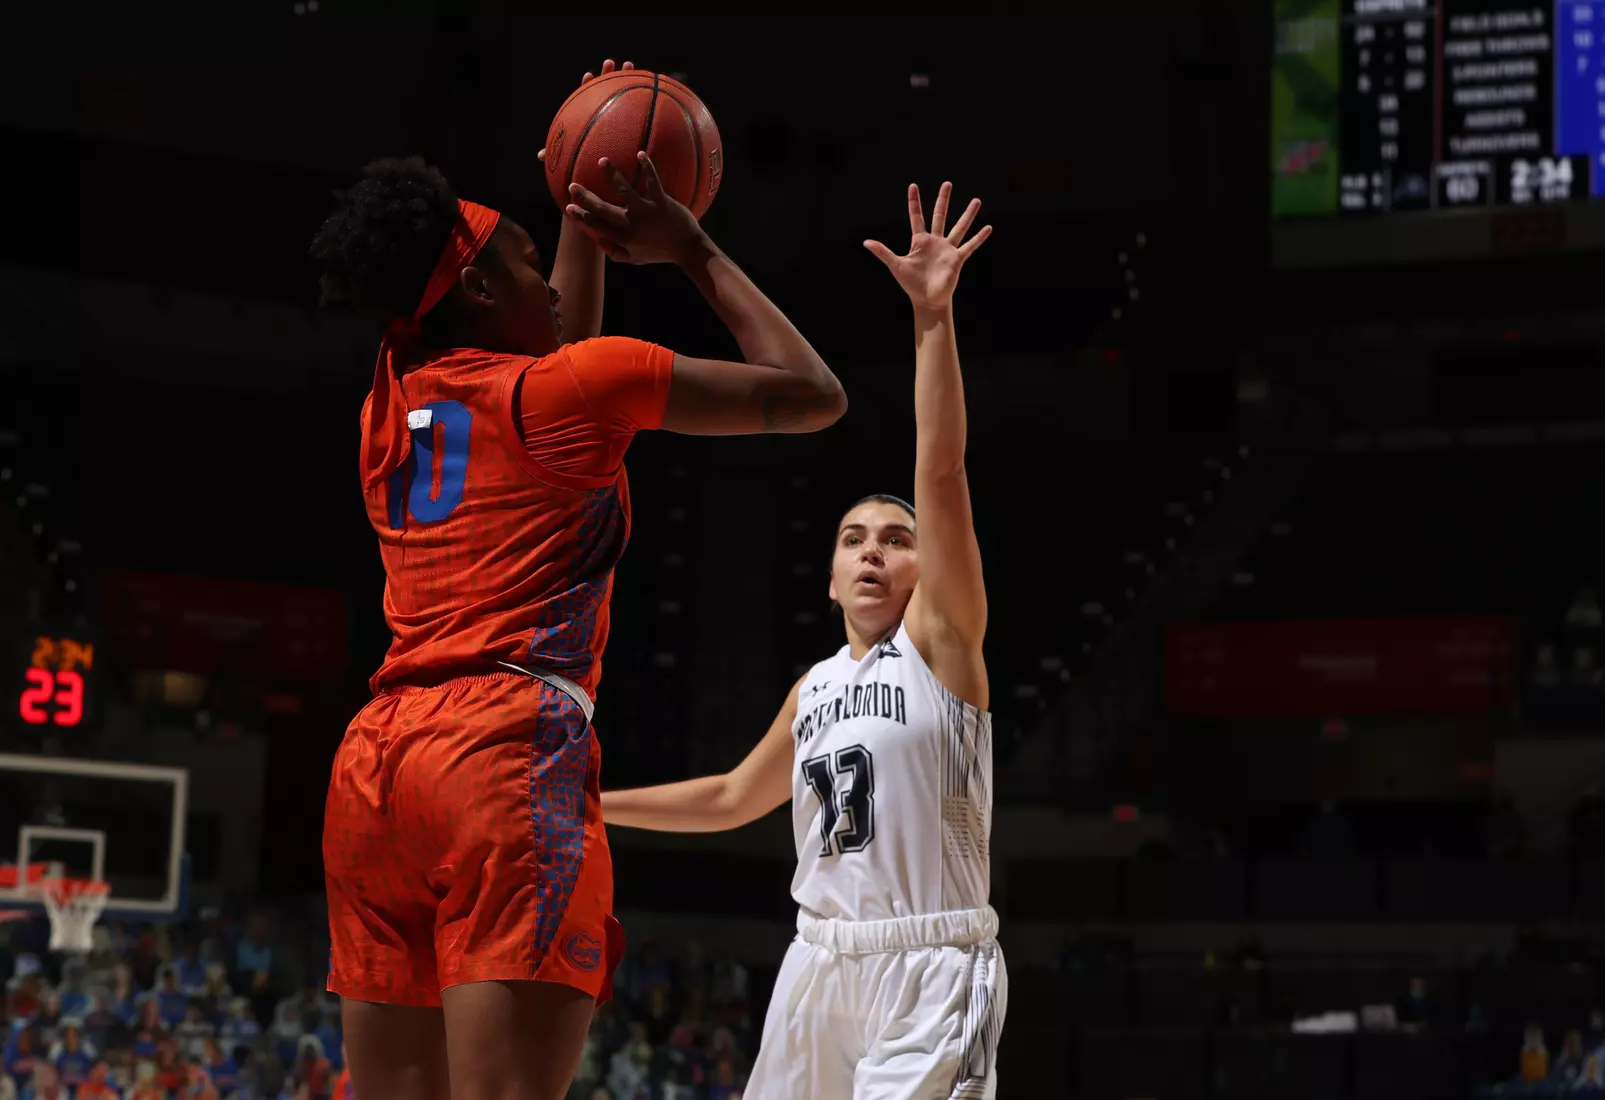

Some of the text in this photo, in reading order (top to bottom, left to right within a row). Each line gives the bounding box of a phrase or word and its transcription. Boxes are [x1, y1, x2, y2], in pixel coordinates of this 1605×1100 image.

[1511, 157, 1572, 184] 2:34
[19, 667, 85, 726] 23
[802, 744, 875, 857] 13
